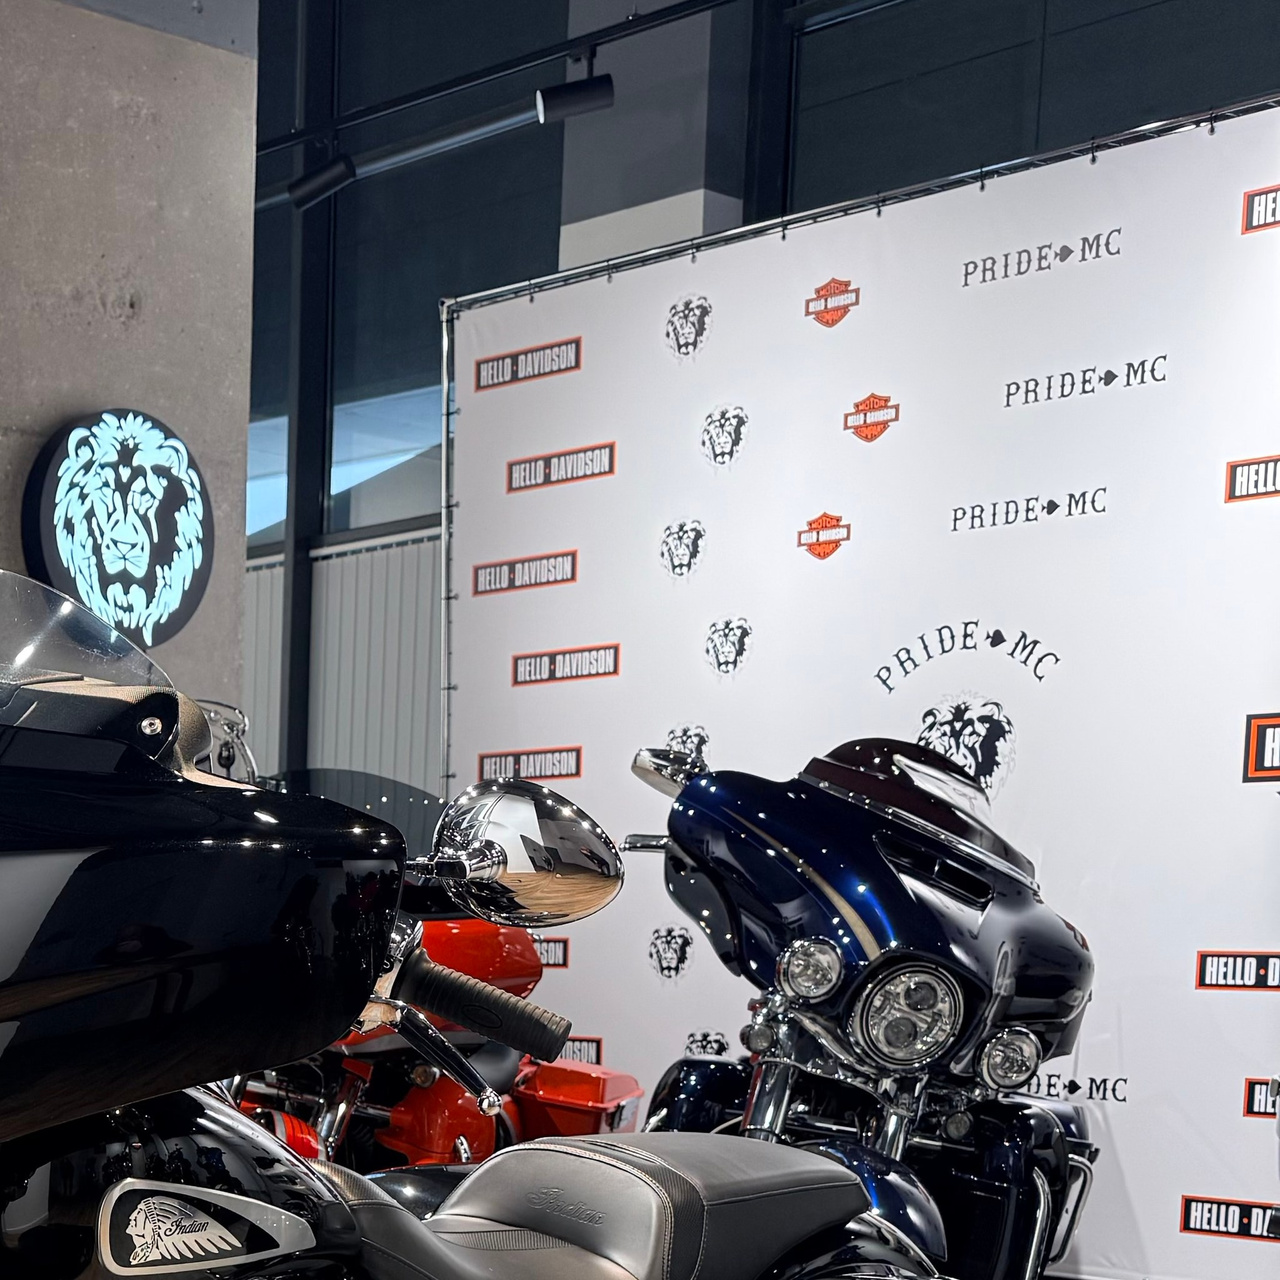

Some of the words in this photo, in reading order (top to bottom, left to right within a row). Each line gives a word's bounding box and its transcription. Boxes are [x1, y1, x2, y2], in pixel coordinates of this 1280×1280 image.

[962, 243, 1054, 287] PRIDE
[1078, 227, 1122, 263] MC
[480, 357, 512, 387] HELLO
[517, 342, 576, 379] DAVIDSON
[1004, 366, 1097, 408] PRIDE
[1123, 354, 1167, 387] MC
[512, 459, 545, 489] HELLO
[550, 447, 610, 482] DAVIDSON
[951, 496, 1040, 531] PRIDE
[1065, 487, 1108, 517] MC
[477, 565, 509, 592] HELLO
[514, 554, 573, 587] DAVIDSON
[517, 655, 550, 682] HELLO
[555, 648, 615, 678] DAVIDSON
[874, 619, 980, 695] PRIDE
[1007, 630, 1061, 682] MC
[483, 755, 515, 780] HELLO
[520, 750, 577, 778] DAVIDSON
[1205, 956, 1257, 986] HELLO
[1087, 1077, 1128, 1103] MC
[525, 1186, 608, 1227] Indian
[1189, 1201, 1240, 1233] HELLO
[163, 1217, 210, 1238] Indian
